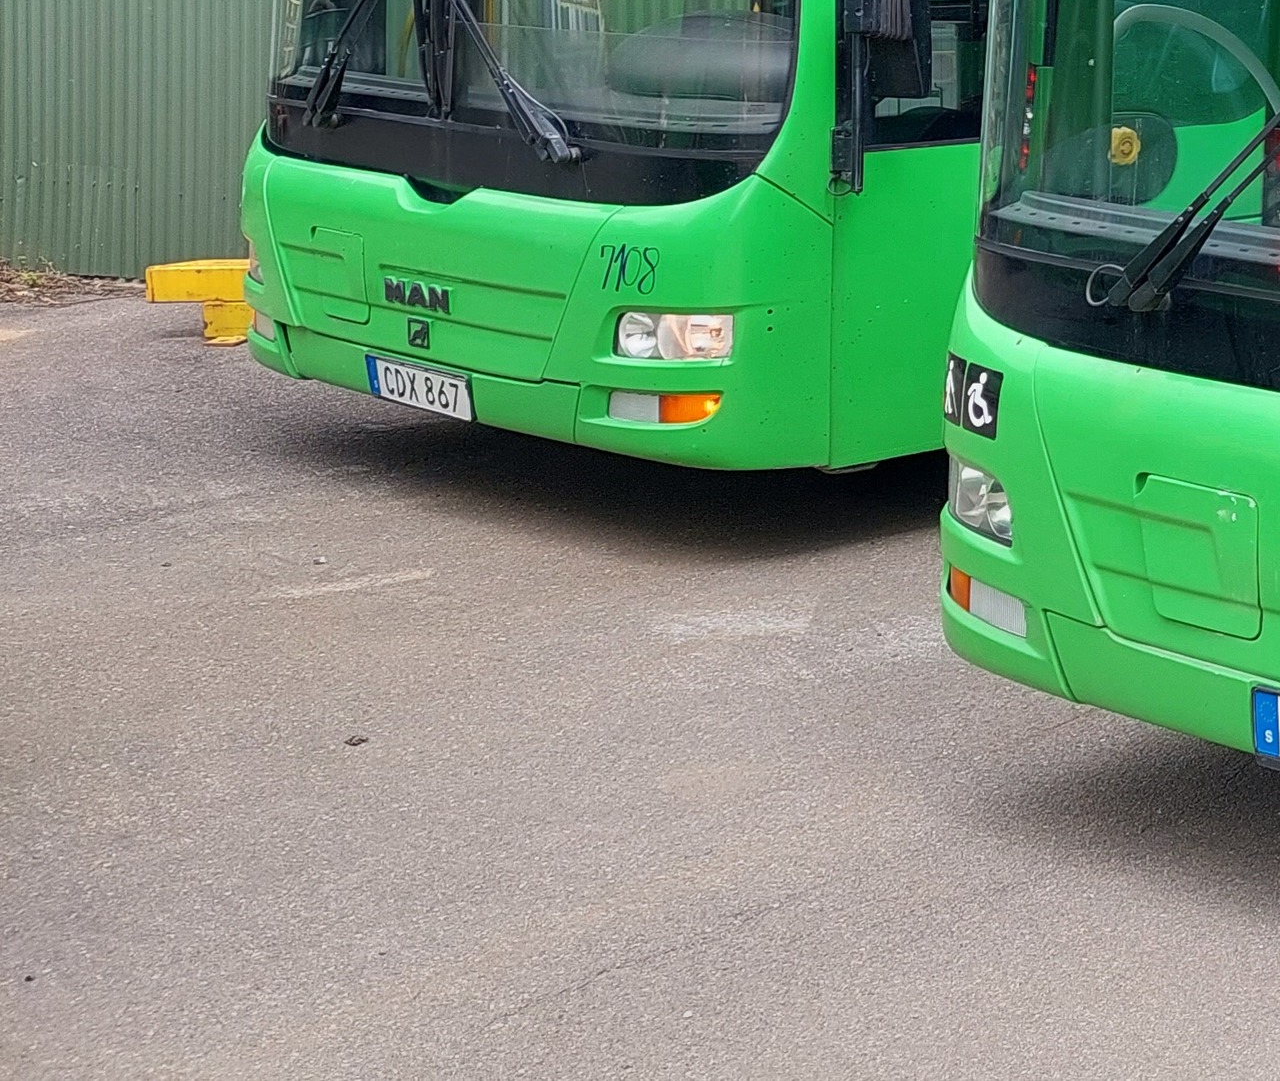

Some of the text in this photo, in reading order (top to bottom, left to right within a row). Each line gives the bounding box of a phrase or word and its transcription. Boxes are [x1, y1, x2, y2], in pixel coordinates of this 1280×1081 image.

[600, 244, 660, 295] 7108
[384, 275, 452, 316] MAN
[383, 365, 420, 403] CDX
[424, 376, 459, 413] 867
[1264, 729, 1274, 743] S
